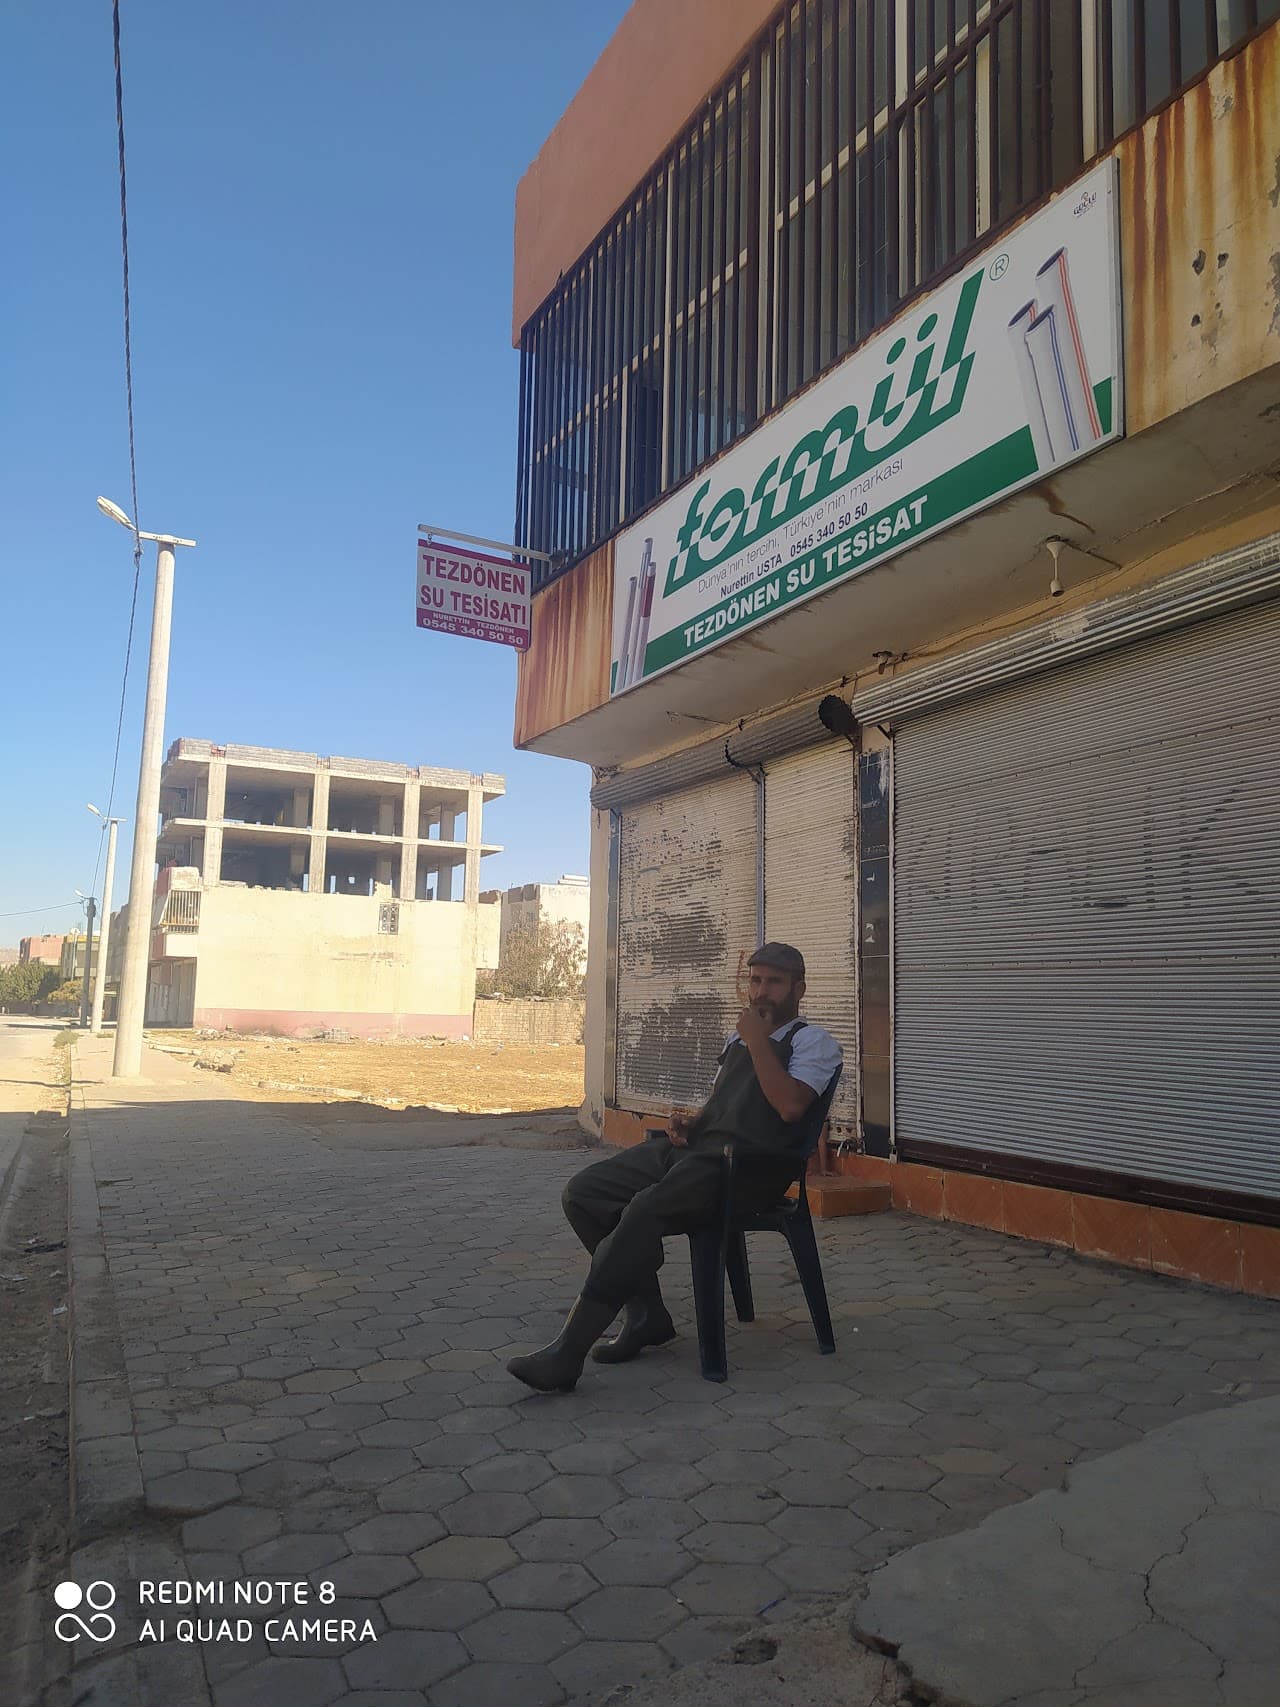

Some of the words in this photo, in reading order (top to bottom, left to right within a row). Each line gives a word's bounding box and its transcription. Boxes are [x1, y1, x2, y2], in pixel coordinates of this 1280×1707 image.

[849, 458, 903, 500] markası
[720, 571, 754, 598] Nurettin
[756, 553, 782, 577] USTA
[790, 534, 814, 557] 0545
[816, 521, 835, 542] 340
[838, 511, 851, 530] 50
[854, 502, 868, 521] 50
[422, 554, 525, 595] TEZDÖNEN
[420, 585, 444, 608] SU
[450, 591, 526, 625] TESİSATI
[683, 578, 780, 648] TEZDÖNEN
[786, 558, 816, 593] SU
[422, 617, 456, 632] 0545
[460, 625, 485, 637] 340
[488, 631, 504, 641] 50
[508, 635, 524, 645] 50
